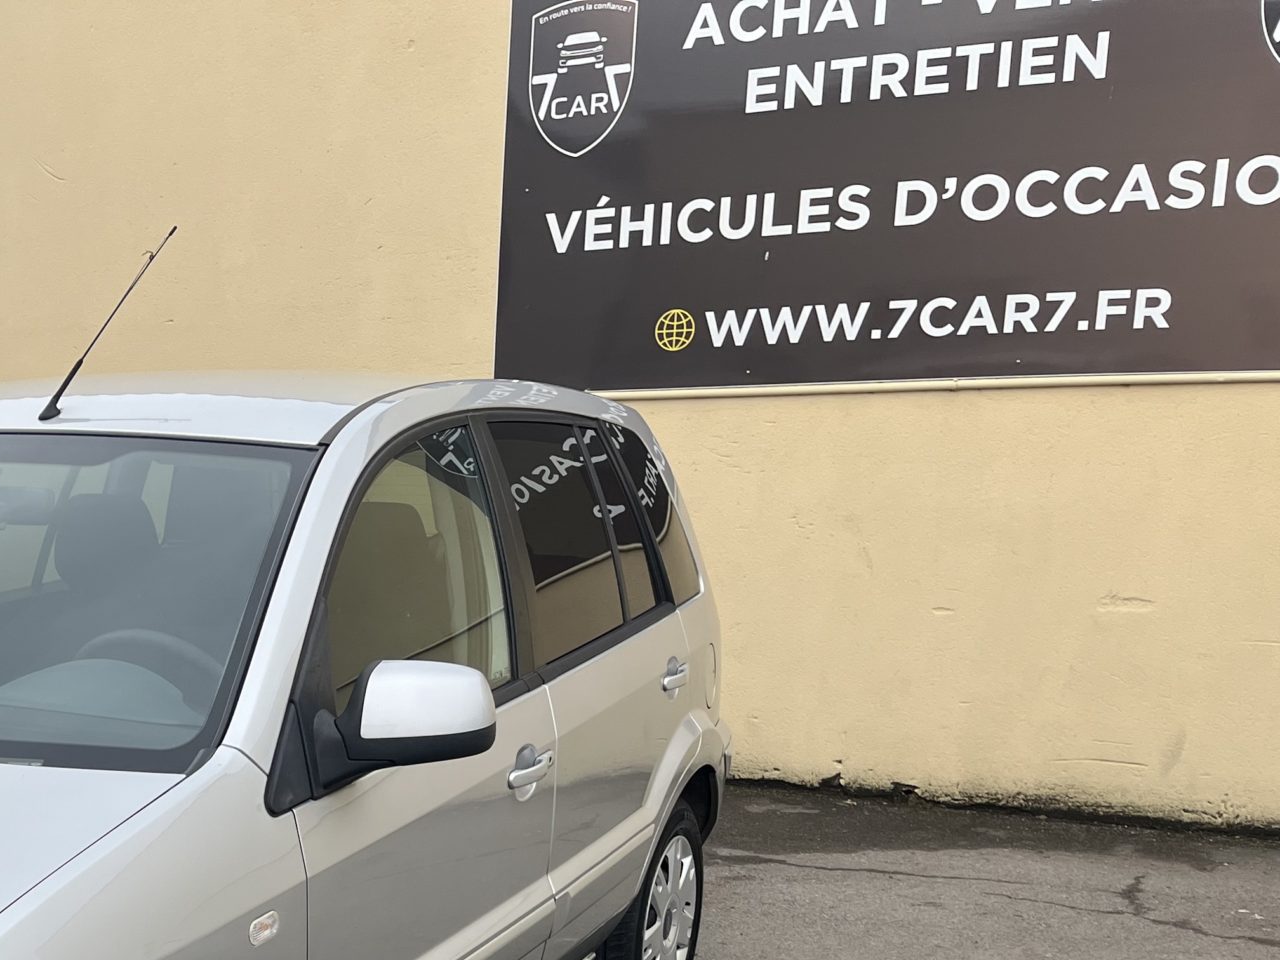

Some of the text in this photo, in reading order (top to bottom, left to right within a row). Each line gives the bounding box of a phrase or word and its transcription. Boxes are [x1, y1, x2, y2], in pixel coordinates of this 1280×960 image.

[539, 16, 549, 25] En
[549, 9, 569, 21] route
[569, 6, 585, 14] vers
[585, 3, 594, 11] la
[593, 2, 628, 13] confiance
[744, 30, 1111, 113] ENTRETIEN
[545, 184, 871, 254] VÉHICULES
[705, 287, 1173, 348] WWW.7CAR7.FR
